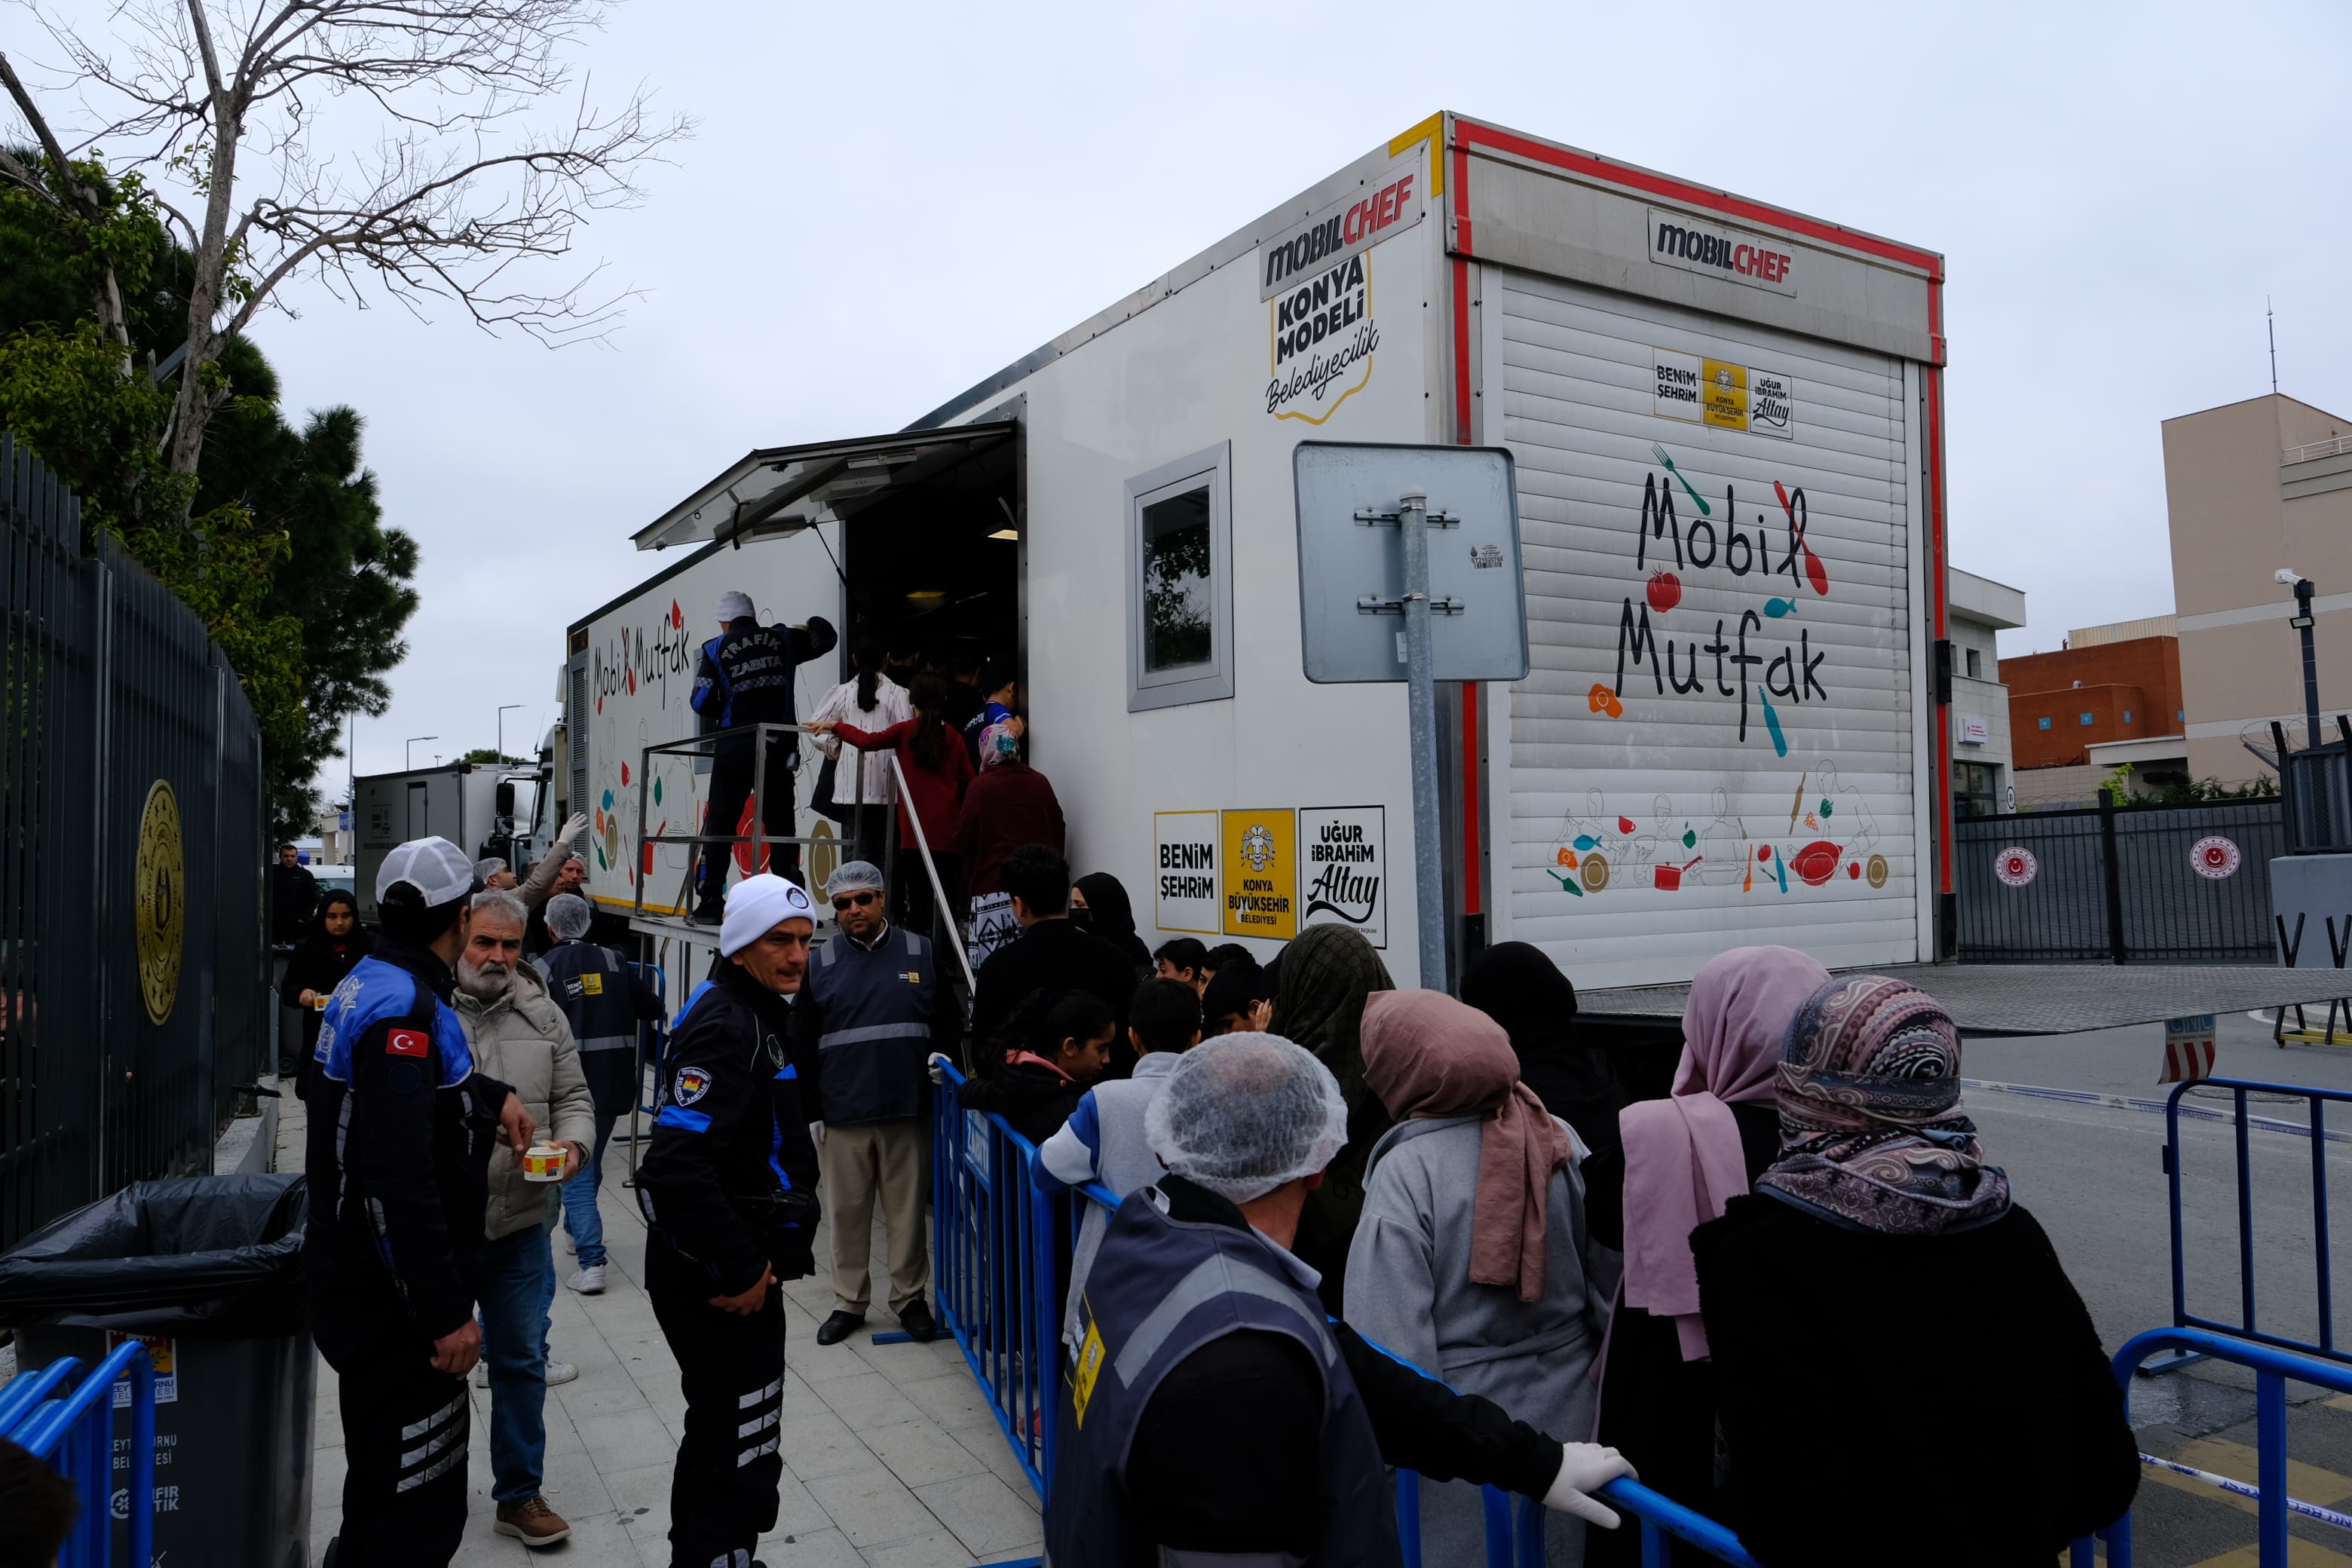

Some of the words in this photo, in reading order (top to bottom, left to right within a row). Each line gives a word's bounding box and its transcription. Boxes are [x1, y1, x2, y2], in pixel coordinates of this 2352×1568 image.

[1278, 255, 1364, 332] KONYA
[1277, 288, 1364, 366] MODELİ
[1266, 319, 1380, 414] Belediyecilik
[1657, 366, 1696, 387] BENİM
[1716, 396, 1734, 405] KONYA
[1753, 397, 1790, 427] Altay
[1638, 472, 1807, 588] Mobil
[593, 626, 629, 706] Mobil
[633, 613, 690, 711] Mutfak
[730, 656, 783, 678] ZABITA
[1615, 597, 1827, 743] Mutfak
[1321, 820, 1362, 843] UĞUR
[1160, 843, 1213, 869] BENİM
[1311, 844, 1374, 862] İBRAHİM
[1160, 874, 1214, 901] ŞEHRİM
[1243, 879, 1273, 893] KONYA
[1306, 863, 1380, 924] Altay
[1229, 892, 1290, 914] BÜYÜKŞEHİR
[1241, 913, 1277, 926] BELEDİYESİ
[153, 1498, 179, 1512] TIK
